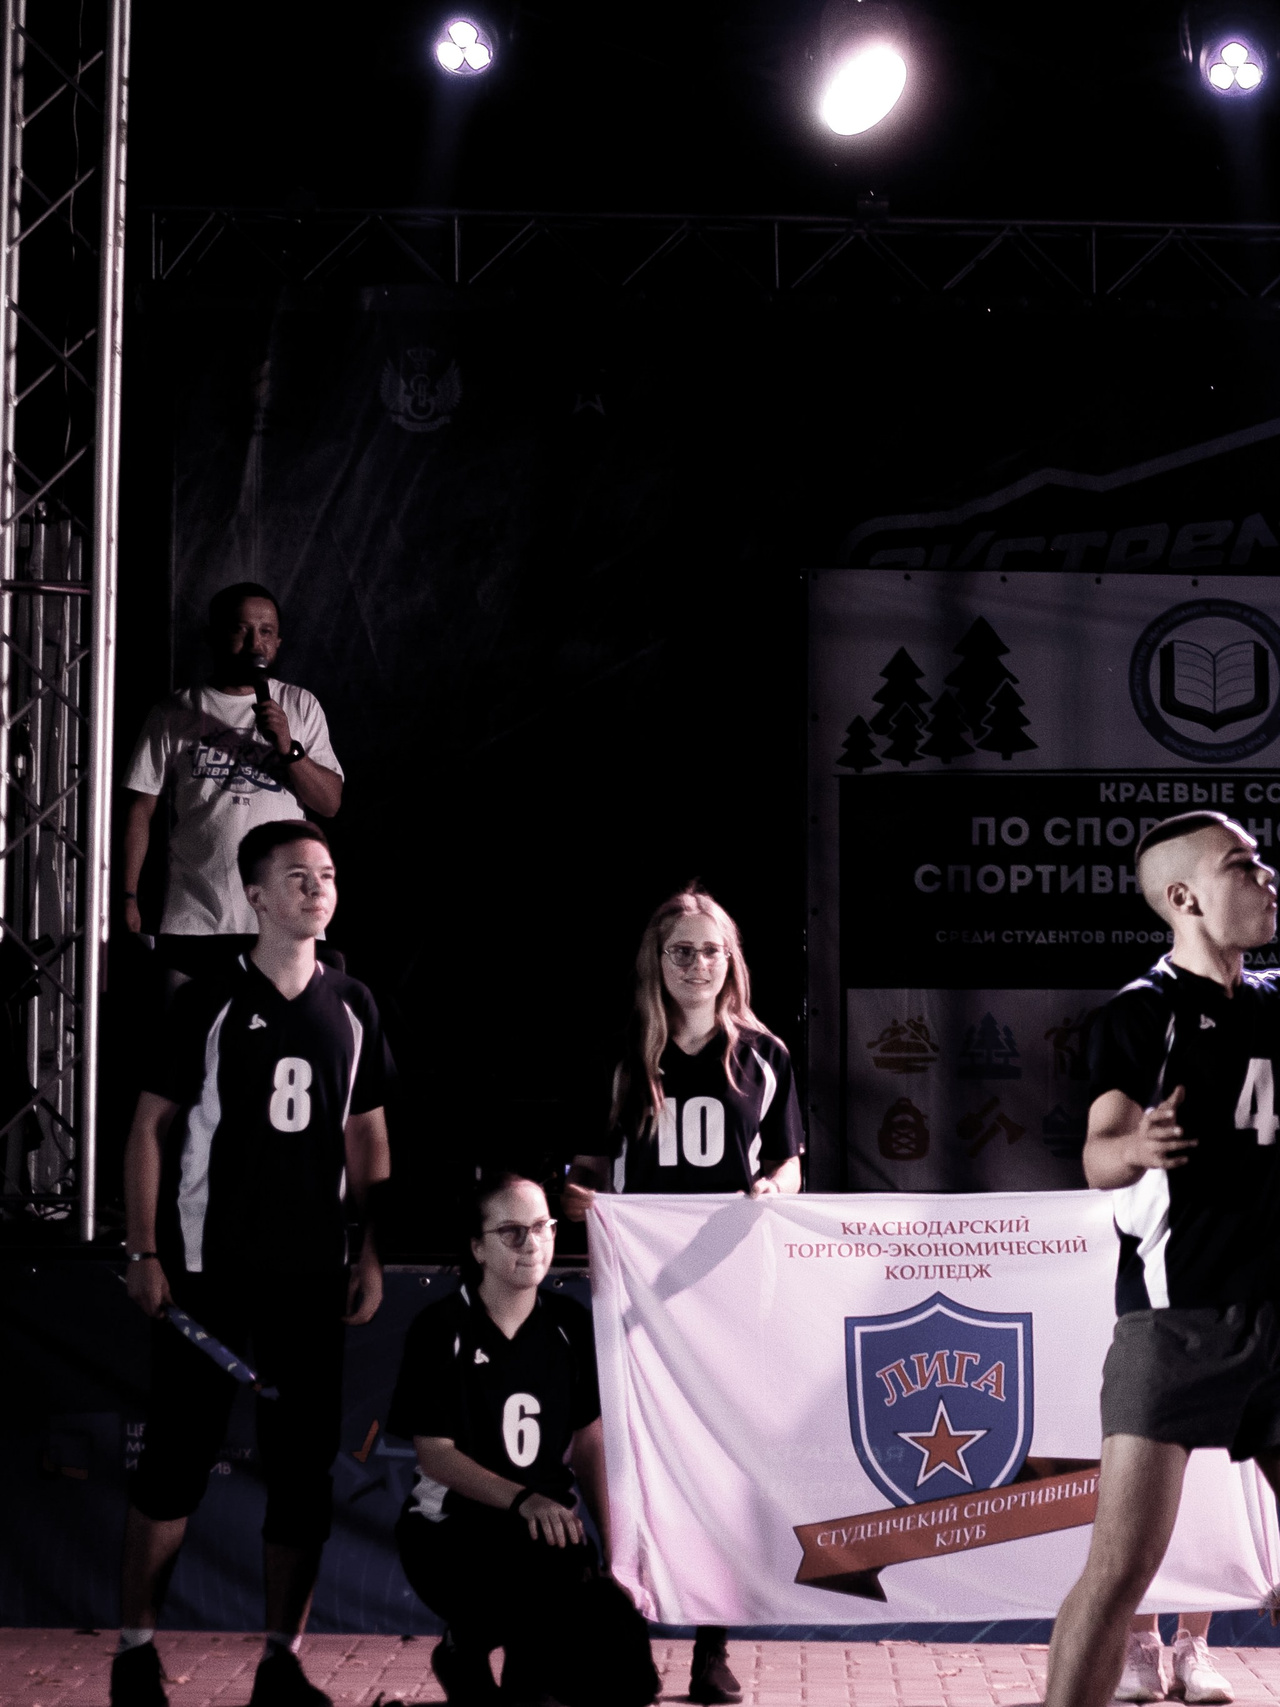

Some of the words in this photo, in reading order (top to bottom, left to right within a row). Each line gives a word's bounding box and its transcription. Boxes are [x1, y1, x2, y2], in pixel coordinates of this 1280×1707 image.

[1100, 782, 1235, 804] КРАЕВЫЕ
[970, 816, 1031, 847] ПО
[935, 930, 996, 944] СРЕДИ
[1001, 930, 1106, 945] СТУДЕНТОВ
[269, 1056, 313, 1133] 8
[1234, 1057, 1280, 1146] 4
[657, 1096, 726, 1168] 10
[841, 1215, 1030, 1238] КРАСНОДАРСКИЙ
[784, 1236, 1088, 1259] ТОРГОВО-ЭКОНОМИЧЕСКИЙ
[884, 1263, 993, 1282] КОЛЛЕДЖ
[876, 1350, 1006, 1407] ЛИГА
[502, 1392, 541, 1467] 6
[816, 1503, 959, 1548] СТУДЕНЧЕКИЙ
[963, 1473, 1100, 1519] СПОРТИВНЫЙ
[935, 1523, 987, 1549] КЛУБ
